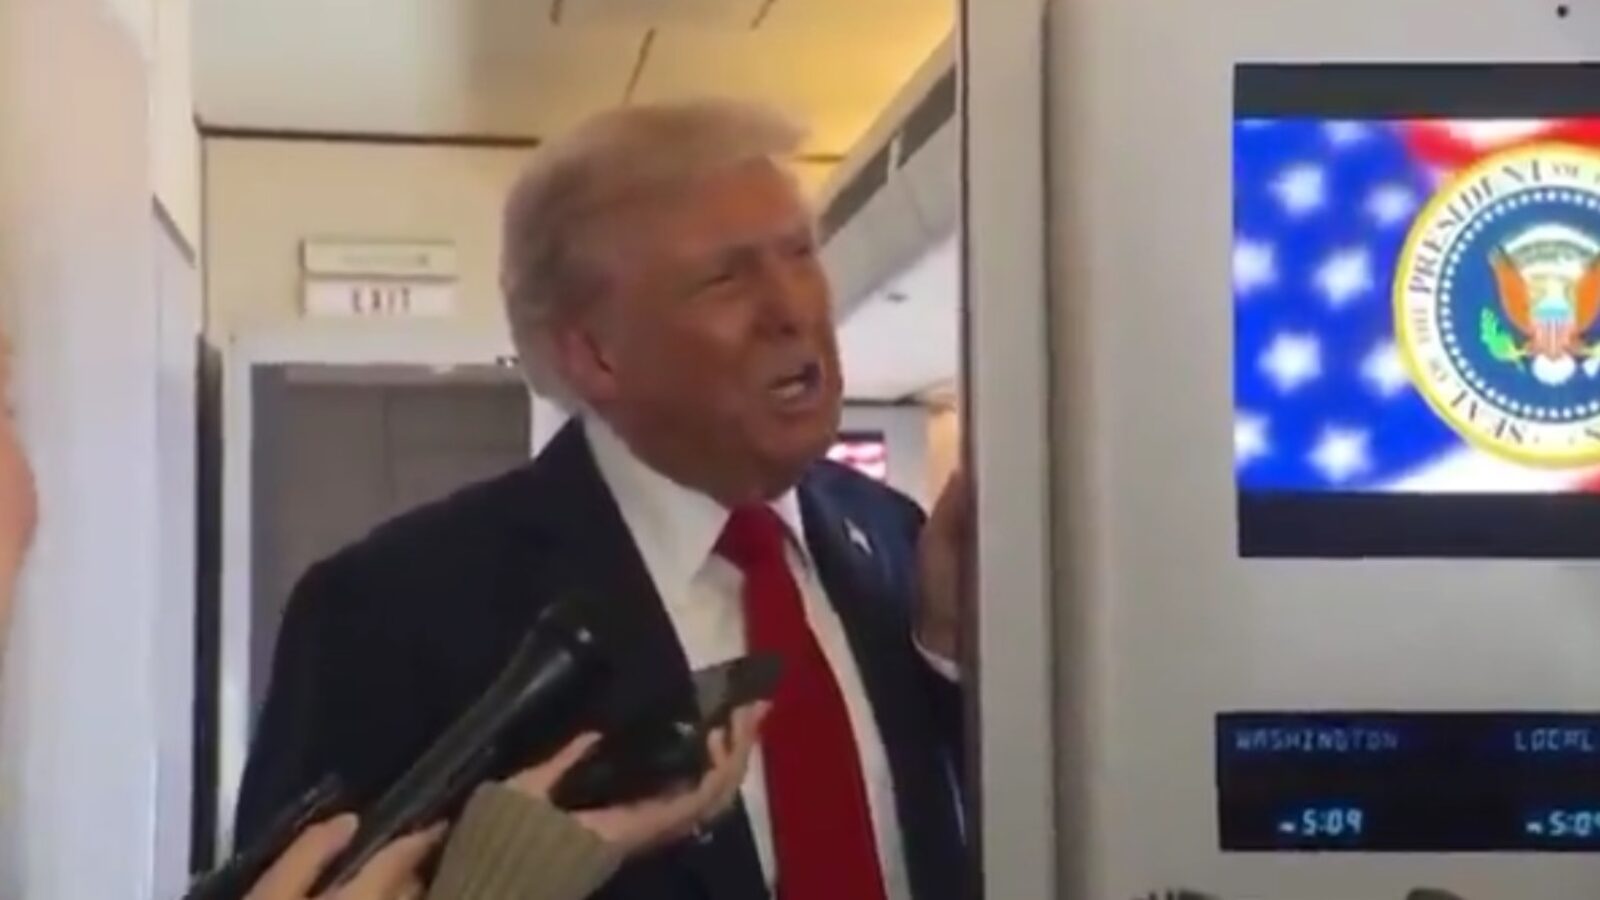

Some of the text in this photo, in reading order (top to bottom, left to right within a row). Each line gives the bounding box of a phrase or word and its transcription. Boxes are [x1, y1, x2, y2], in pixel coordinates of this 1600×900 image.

[1407, 158, 1543, 295] PRESIDENT
[351, 286, 412, 315] EXIT
[1234, 727, 1399, 752] WASHINGTON
[1513, 728, 1594, 752] LOCAL
